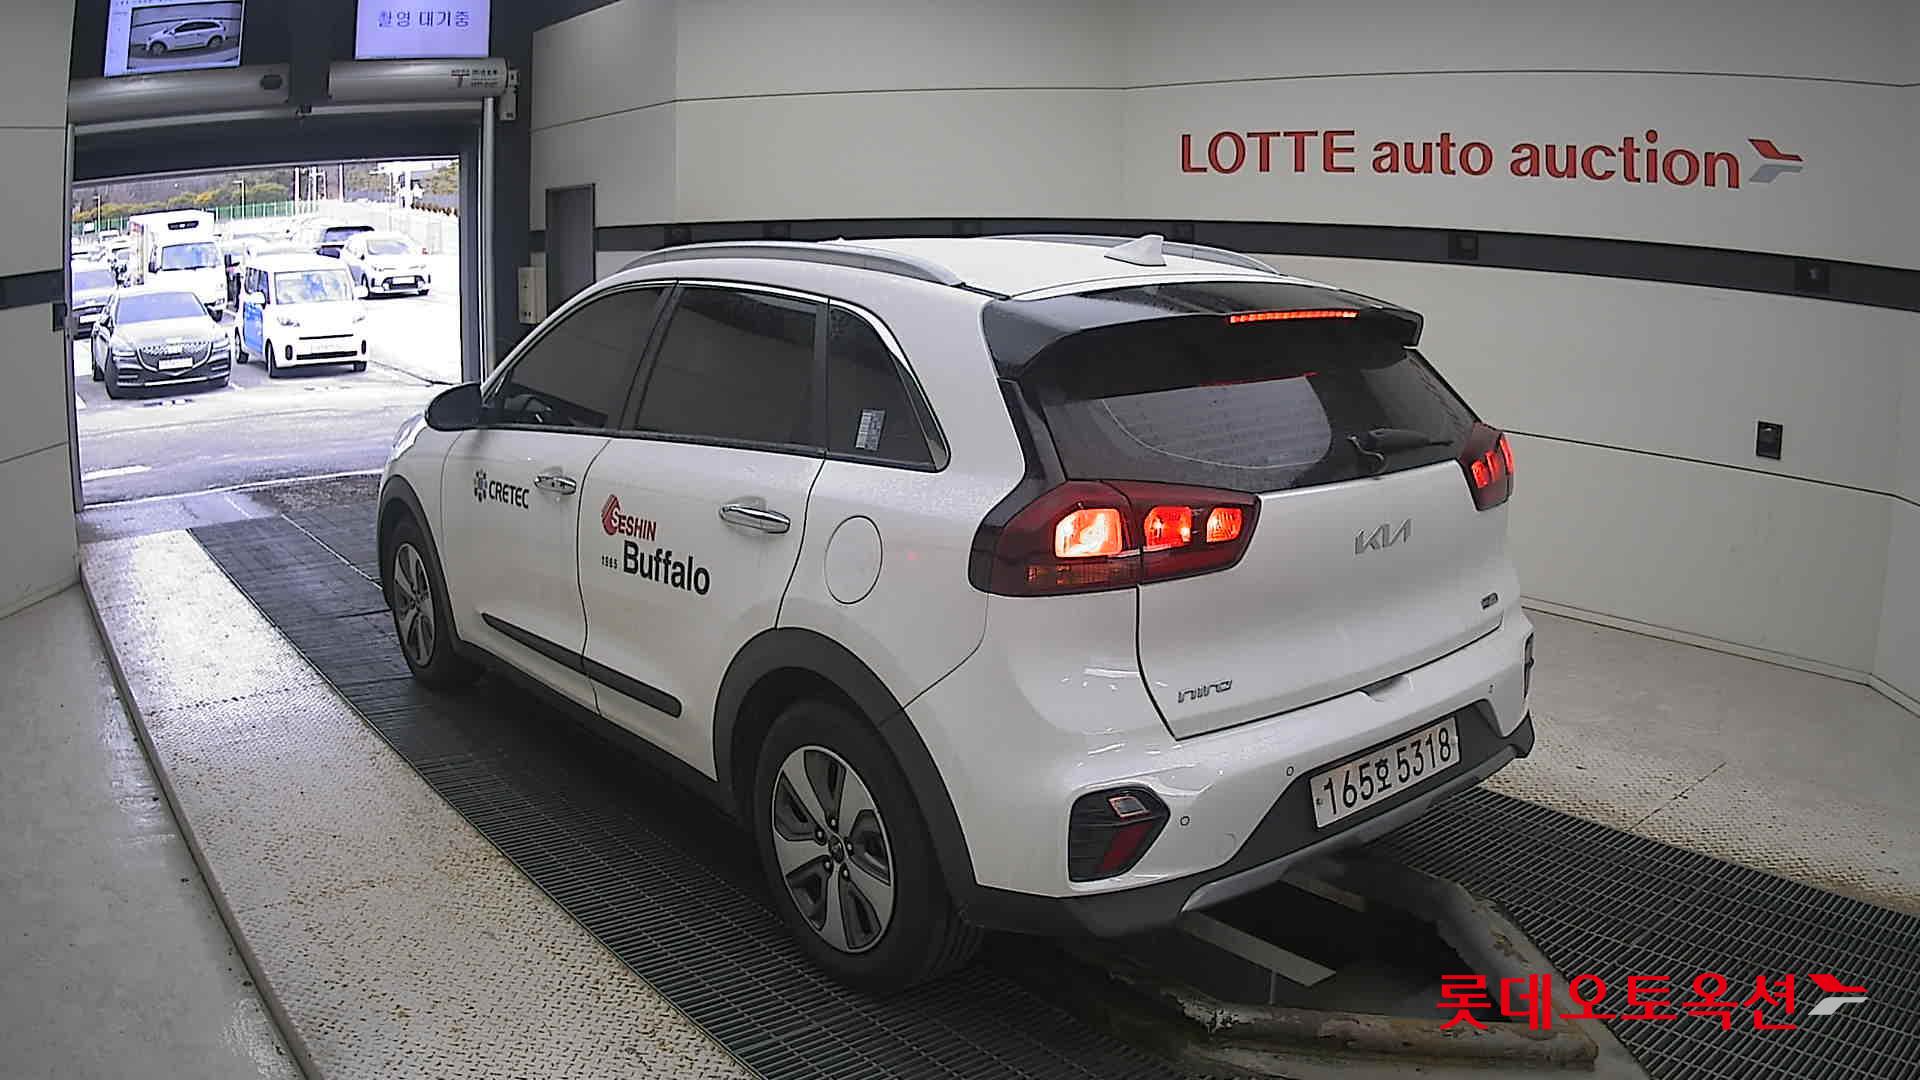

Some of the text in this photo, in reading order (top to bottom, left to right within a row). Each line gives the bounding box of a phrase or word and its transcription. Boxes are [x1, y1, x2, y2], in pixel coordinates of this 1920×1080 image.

[418, 10, 470, 28] 대기중
[1180, 130, 1740, 189] LOTTE auto auction
[488, 479, 530, 509] CRETEC
[611, 507, 657, 541] SESHIN
[623, 539, 710, 596] Buffalo
[1323, 727, 1451, 815] 165호 5318
